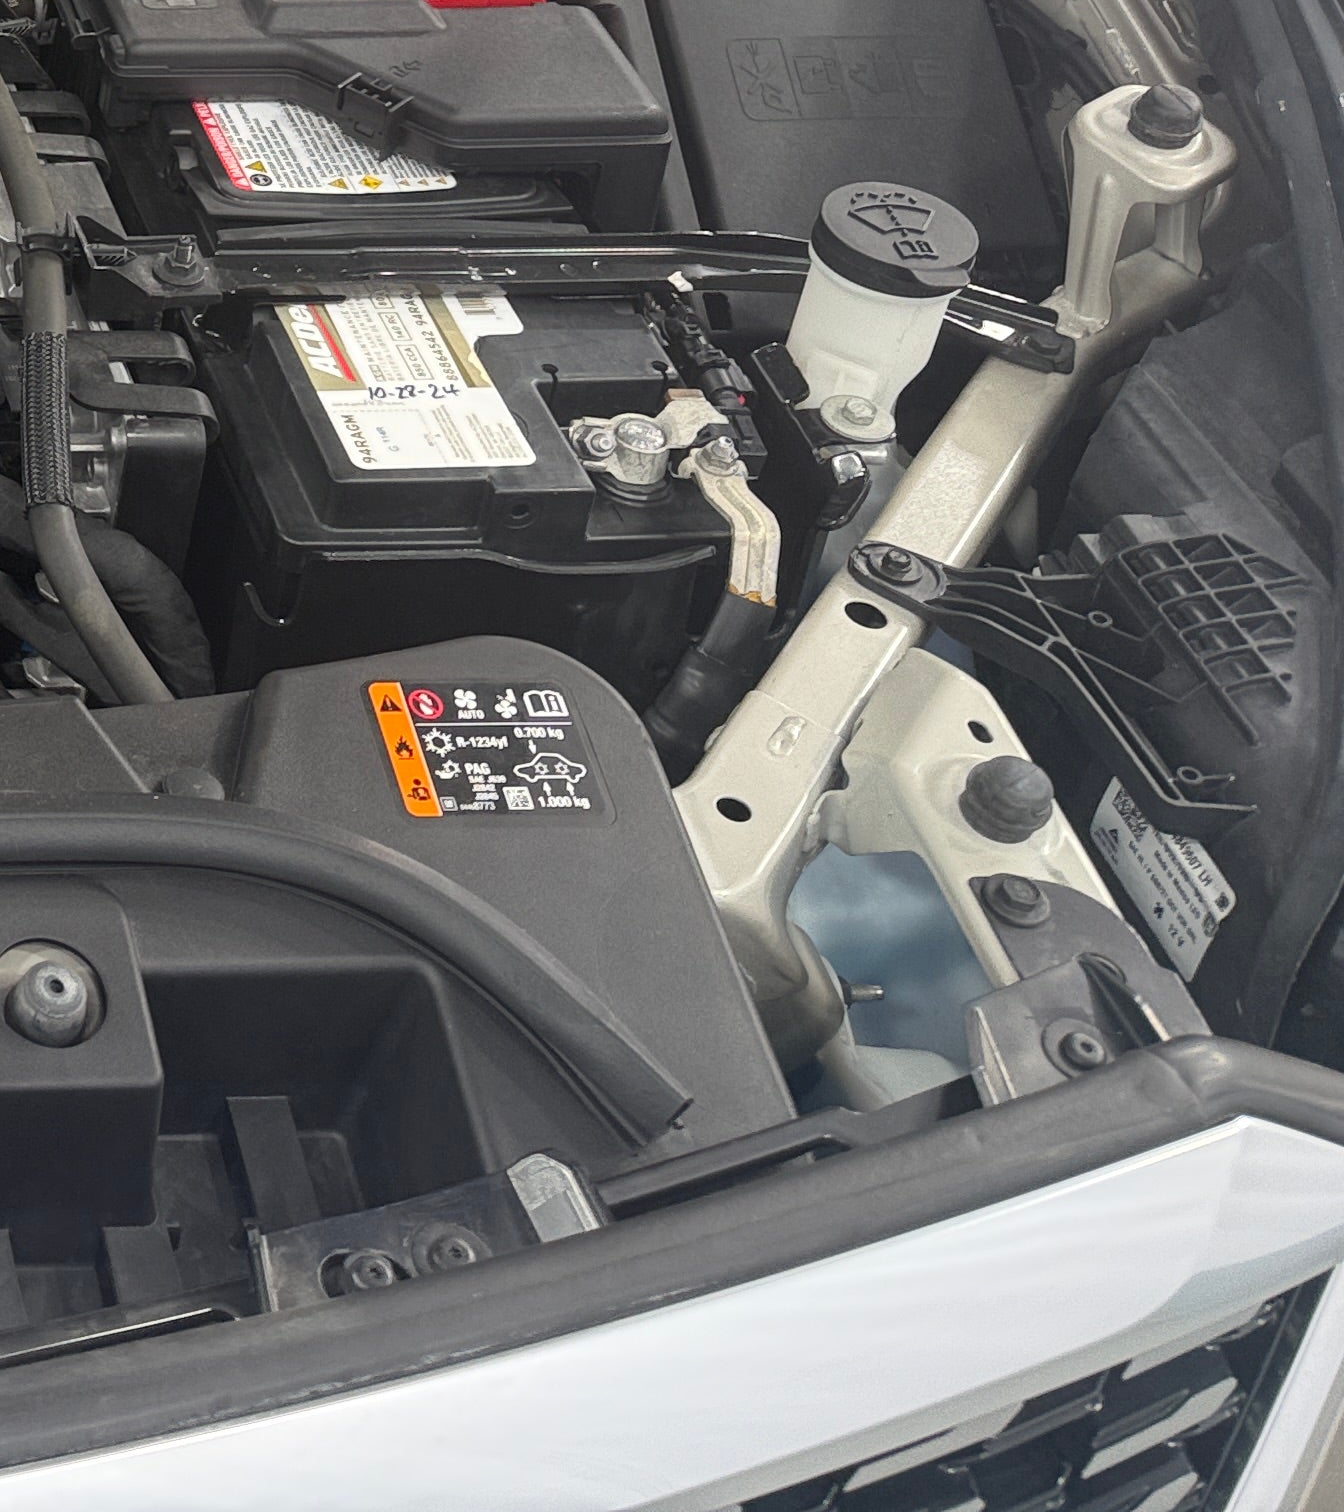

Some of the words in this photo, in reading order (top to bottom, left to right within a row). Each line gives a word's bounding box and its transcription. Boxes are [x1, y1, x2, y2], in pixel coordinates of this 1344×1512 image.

[400, 291, 427, 326] 94RAG
[391, 325, 405, 339] 140
[287, 304, 344, 378] ACDe
[421, 330, 458, 381] 88864542
[368, 384, 461, 400] 10-28-24
[341, 414, 377, 464] 94RAGM
[458, 710, 485, 719] AUTO
[514, 727, 546, 738] 0.700
[547, 727, 564, 740] kg
[455, 736, 508, 749] R-1234yf
[464, 762, 491, 775] PAG
[538, 796, 572, 807] 1.000
[573, 796, 591, 809] kg
